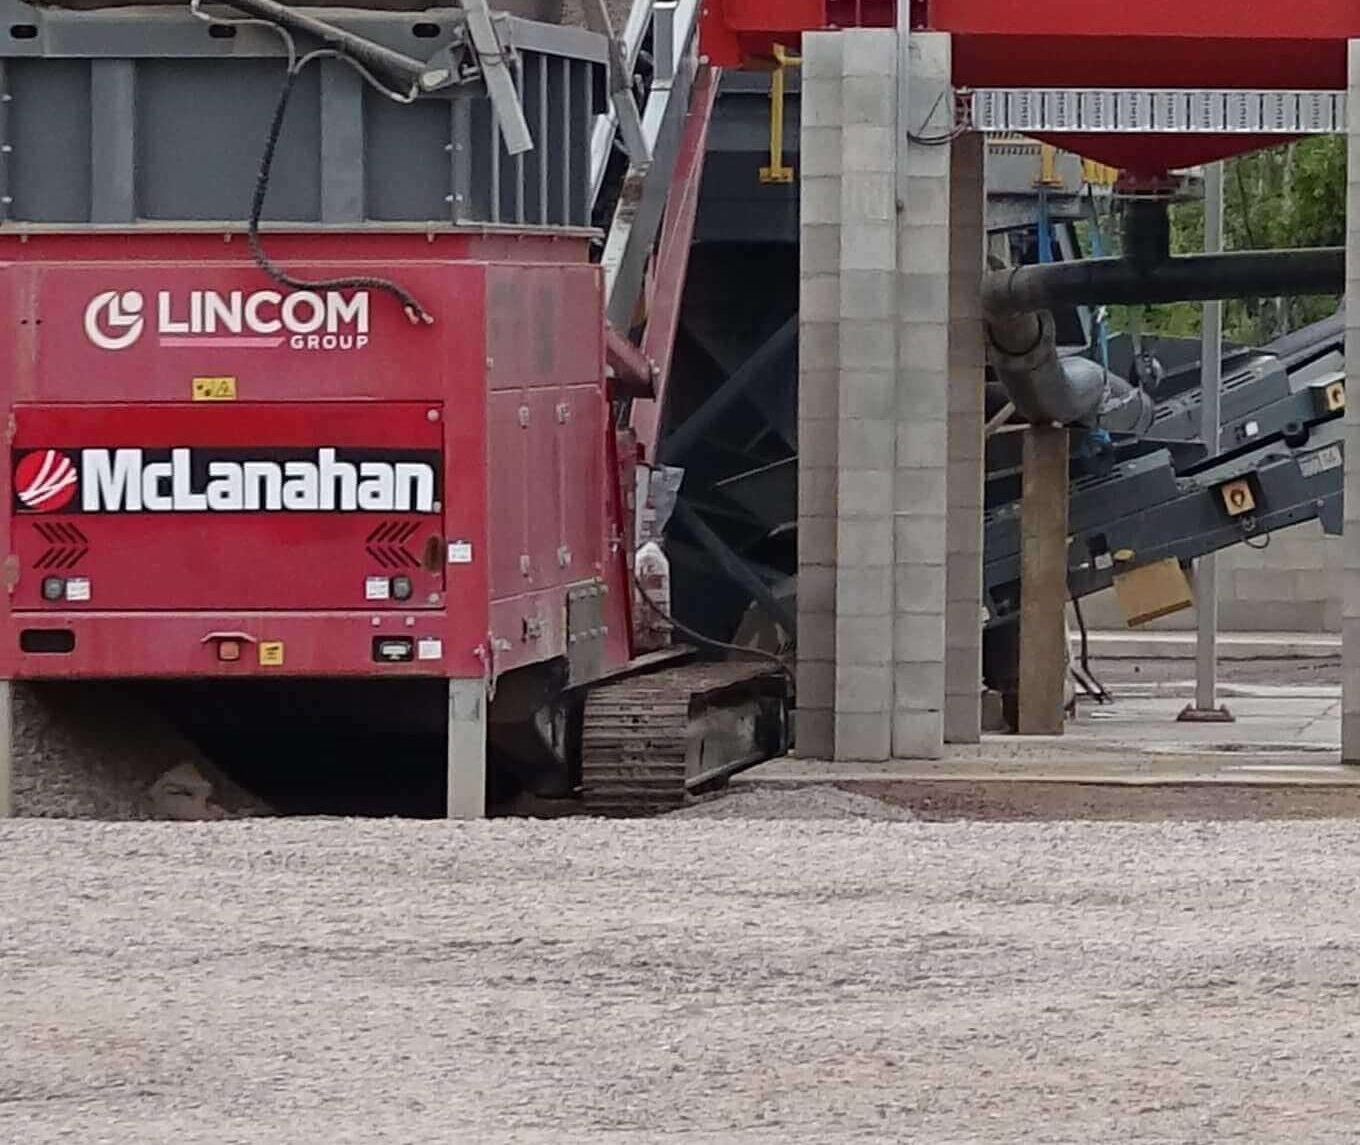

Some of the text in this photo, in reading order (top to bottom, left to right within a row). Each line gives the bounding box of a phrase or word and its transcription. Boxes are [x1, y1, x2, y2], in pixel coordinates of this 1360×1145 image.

[158, 290, 369, 334] LINCOM
[289, 334, 369, 350] GROUP
[81, 447, 435, 512] McLanahan
